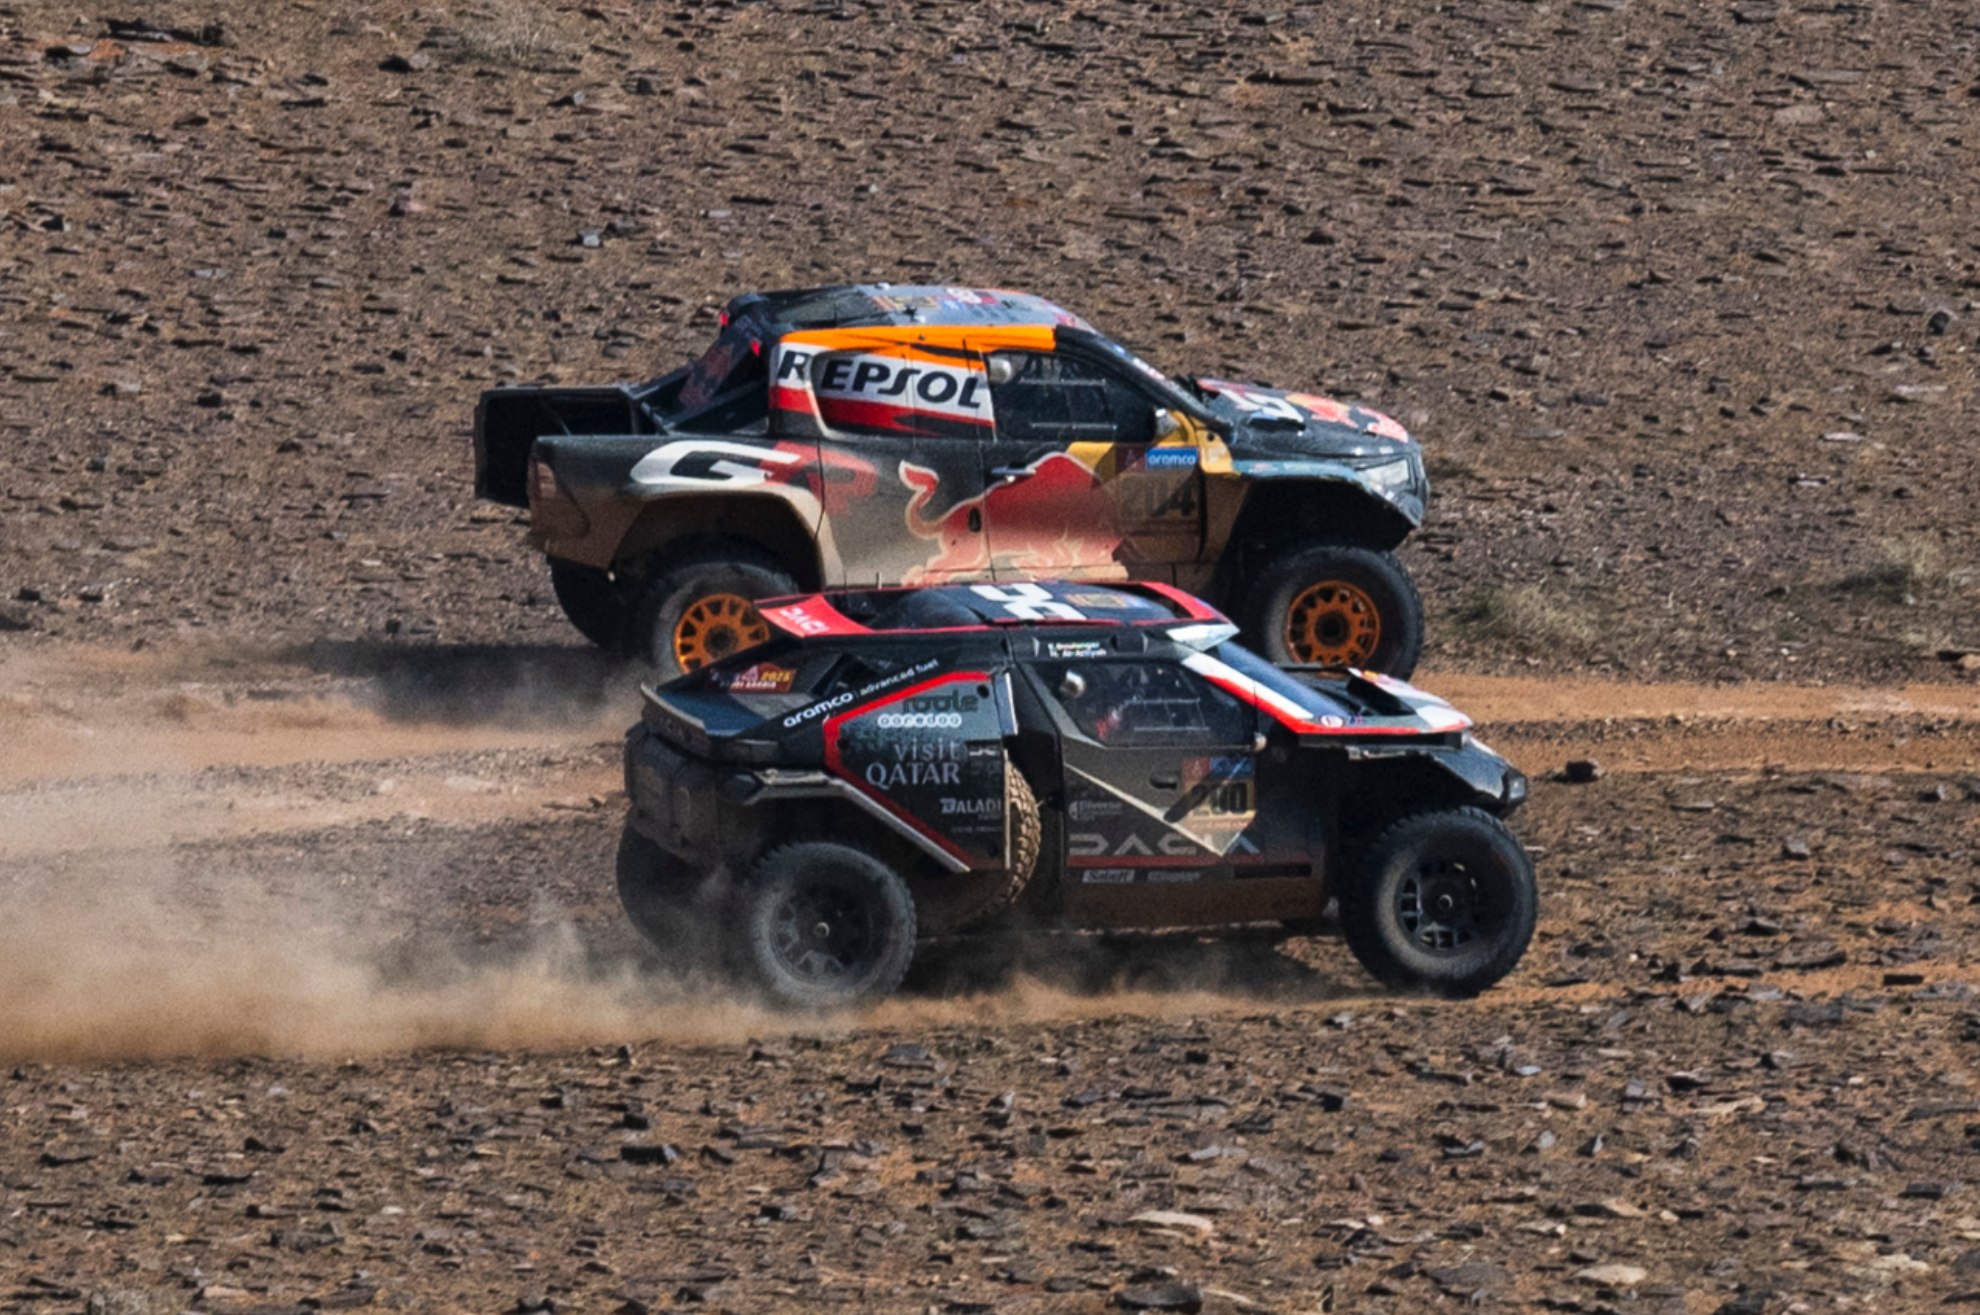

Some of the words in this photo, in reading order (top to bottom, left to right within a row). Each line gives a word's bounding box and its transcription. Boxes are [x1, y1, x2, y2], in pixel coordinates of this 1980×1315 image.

[777, 350, 982, 409] REPSOL
[1147, 454, 1197, 466] aramco
[630, 439, 878, 516] GR
[783, 691, 854, 728] aramco
[859, 667, 916, 697] advanced
[915, 658, 940, 674] fuel
[877, 712, 962, 729] ooredoo
[894, 737, 960, 761] visit
[866, 763, 961, 790] QATAR
